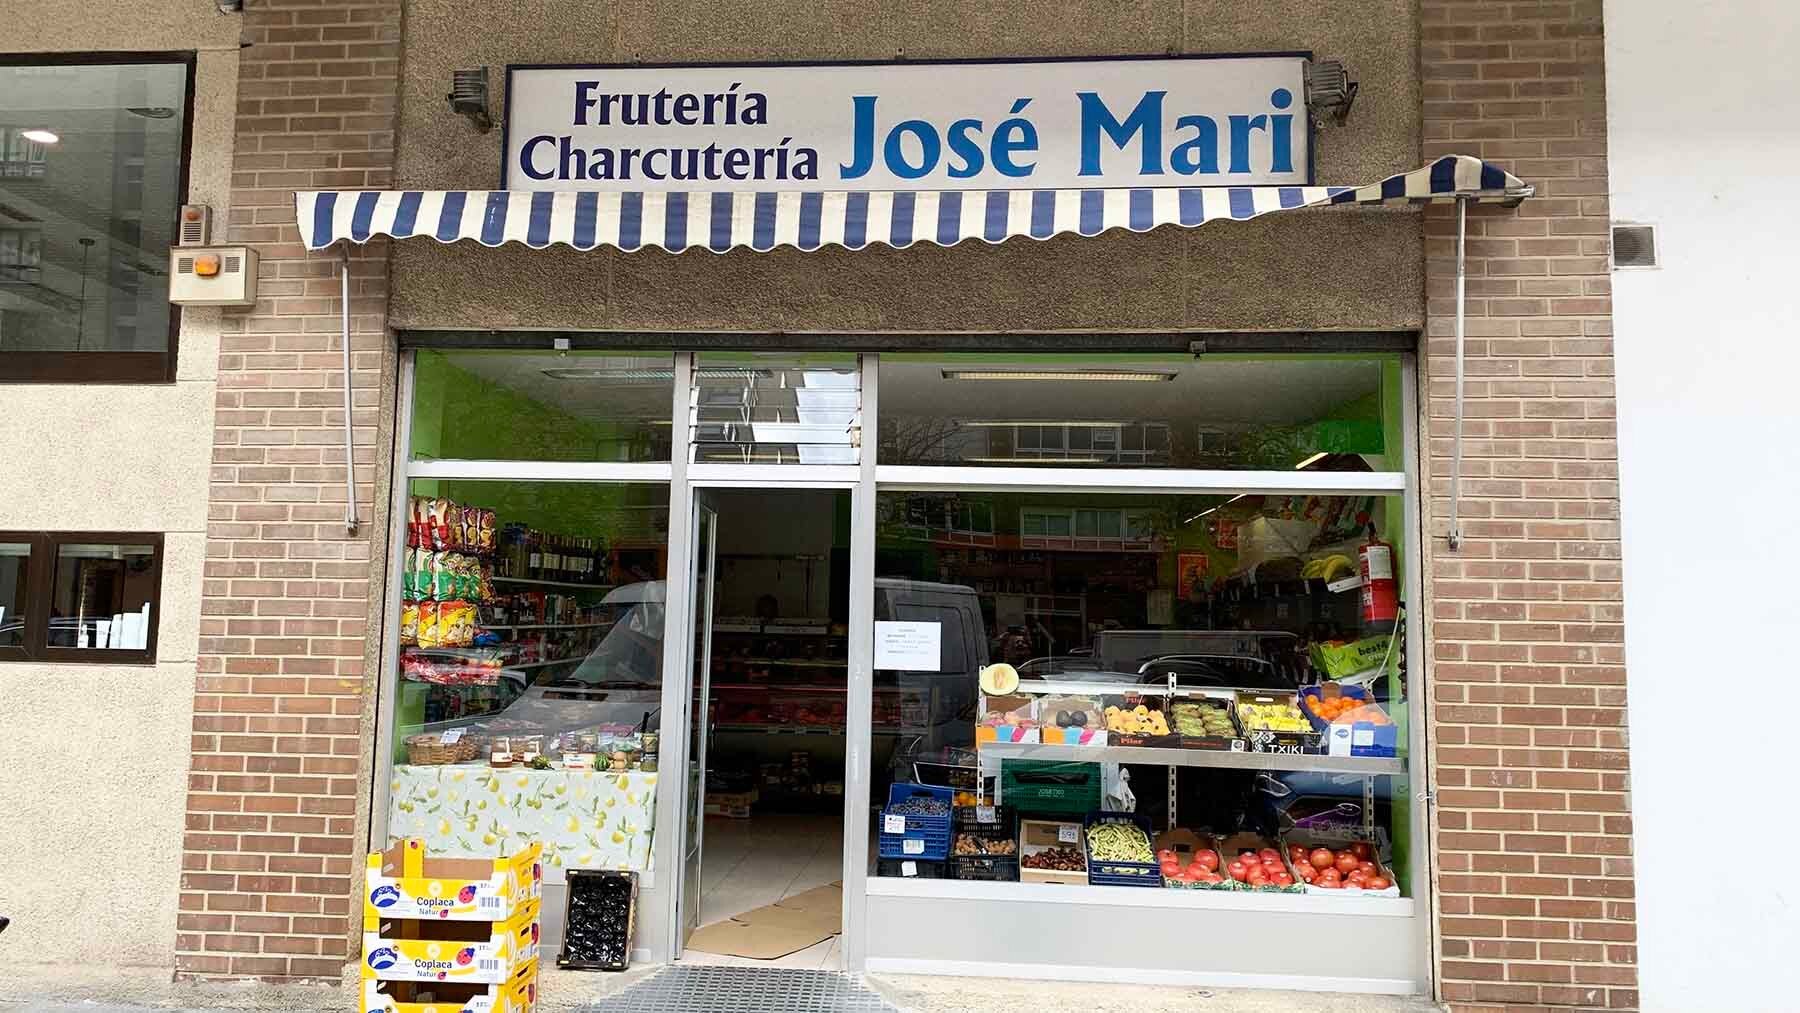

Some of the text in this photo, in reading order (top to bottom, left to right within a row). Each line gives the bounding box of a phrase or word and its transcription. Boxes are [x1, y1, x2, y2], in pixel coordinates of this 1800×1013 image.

[574, 81, 767, 126] Frutería
[839, 88, 1293, 182] José Mari
[520, 136, 819, 181] Charcutería
[1268, 744, 1304, 755] TXIKI
[416, 896, 454, 908] Coplaca
[418, 907, 439, 916] Natur
[414, 958, 453, 970] Coplaca
[416, 969, 437, 977] Natur
